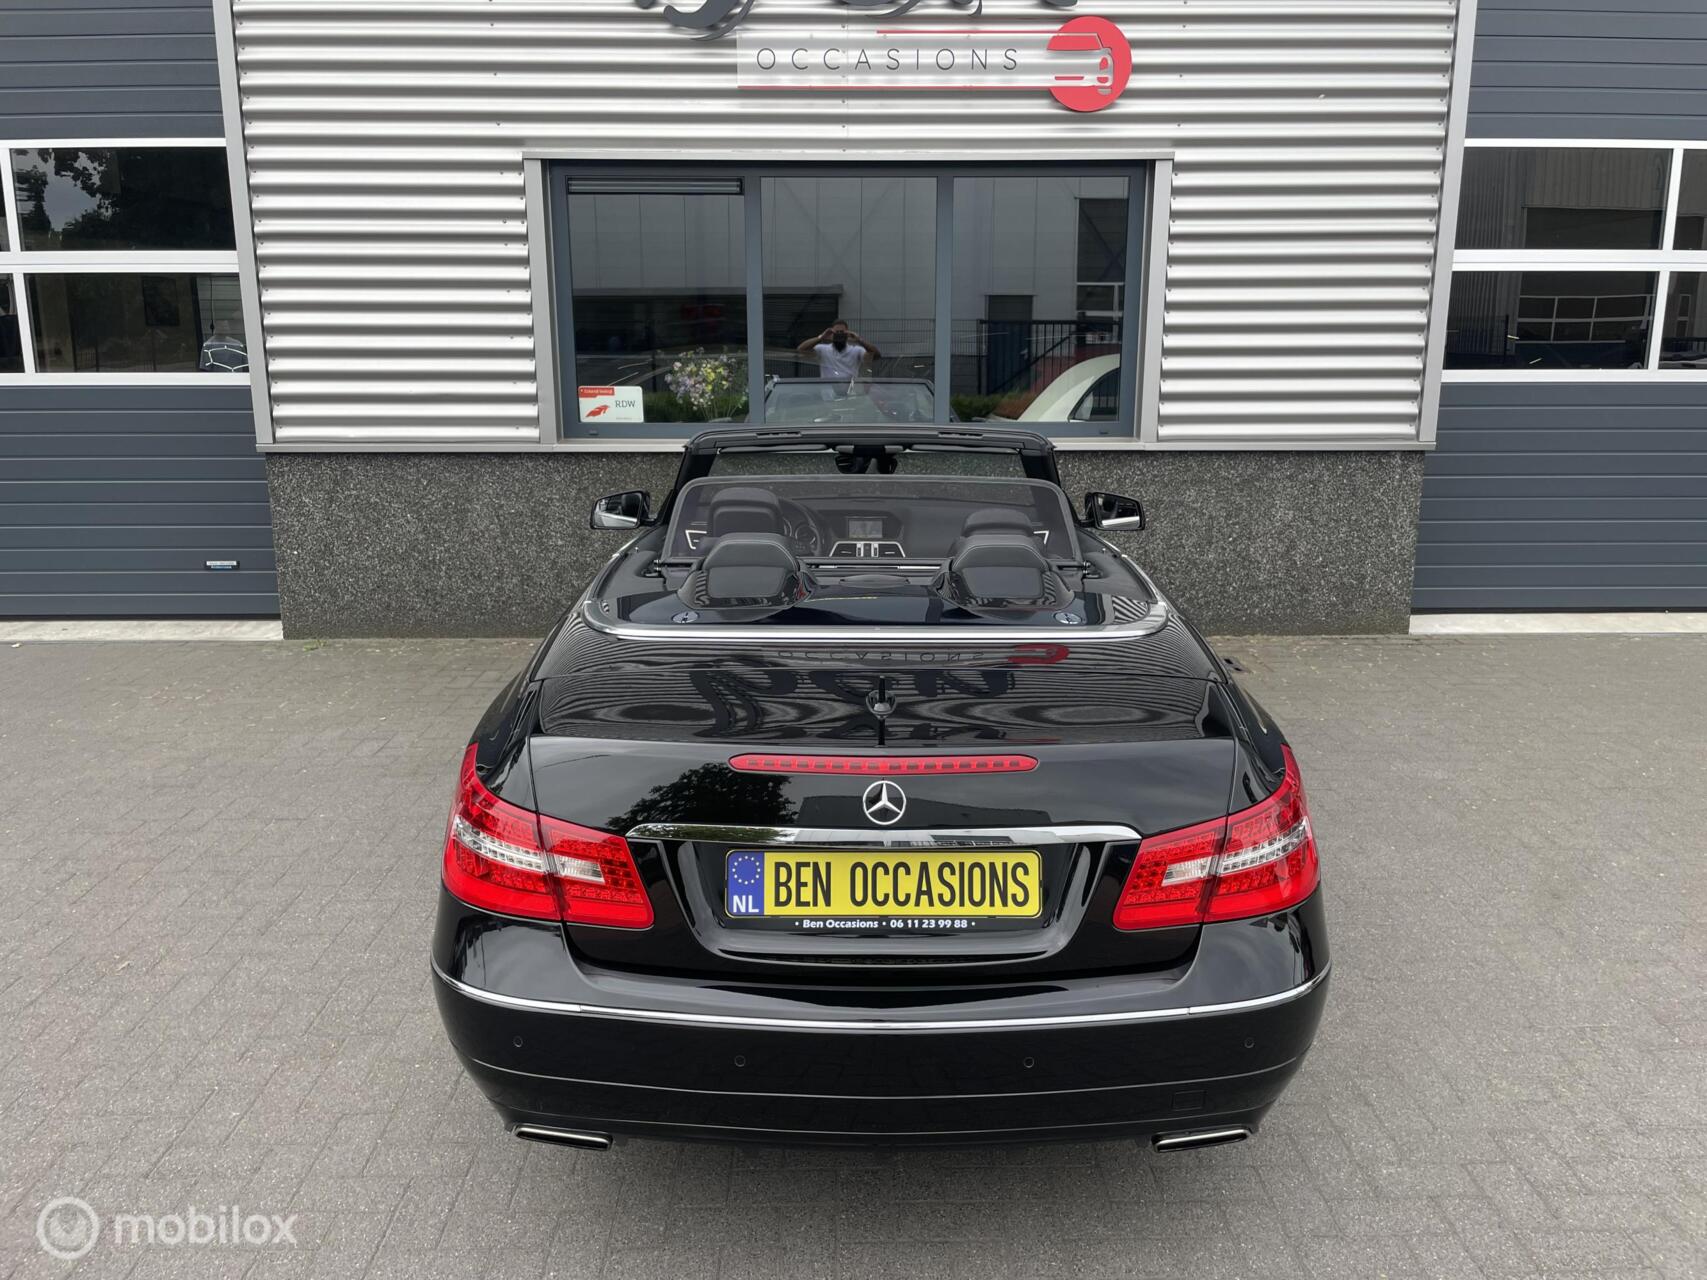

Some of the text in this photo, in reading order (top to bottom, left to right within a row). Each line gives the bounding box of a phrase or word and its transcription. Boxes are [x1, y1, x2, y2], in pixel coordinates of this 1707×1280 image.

[756, 47, 1018, 71] OCCASIONS
[615, 400, 636, 408] RDW
[774, 861, 1030, 907] BEN OCCASIONS
[733, 895, 759, 913] NL
[802, 919, 968, 929] Ben Occasions 06 11 23 99 88
